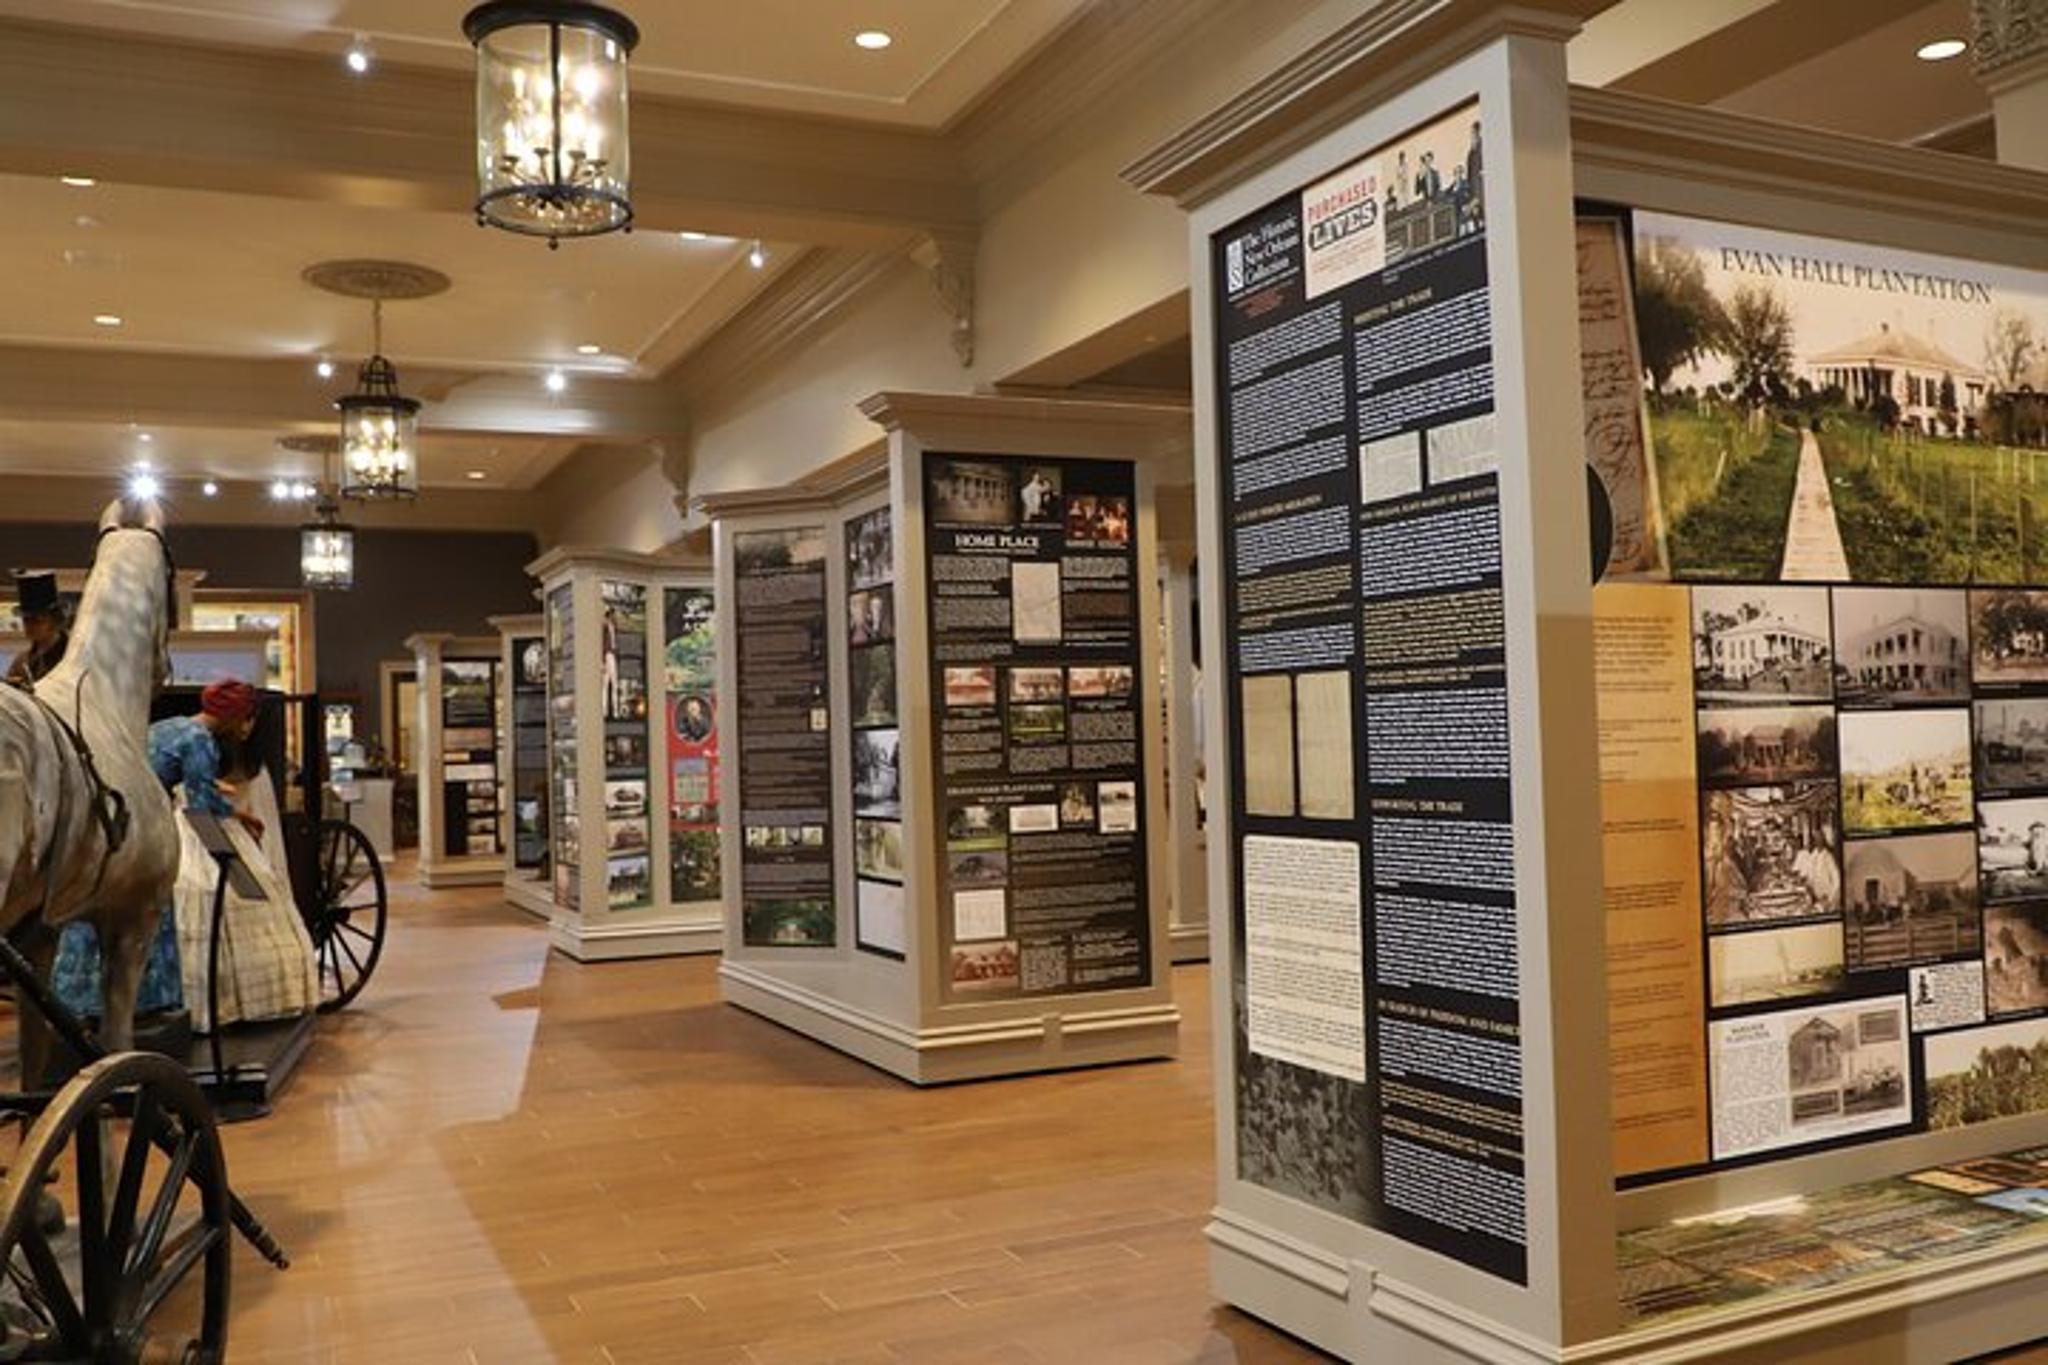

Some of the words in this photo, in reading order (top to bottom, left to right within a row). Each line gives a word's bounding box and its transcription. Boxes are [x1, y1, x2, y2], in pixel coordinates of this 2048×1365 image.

[1308, 176, 1377, 222] PURCHASED
[1311, 200, 1375, 249] LIVES
[1720, 247, 1783, 275] EVAN
[1790, 256, 1849, 287] HALL
[1854, 264, 1992, 304] PLANTATION
[954, 533, 996, 548] HOME
[999, 534, 1040, 548] PLACE
